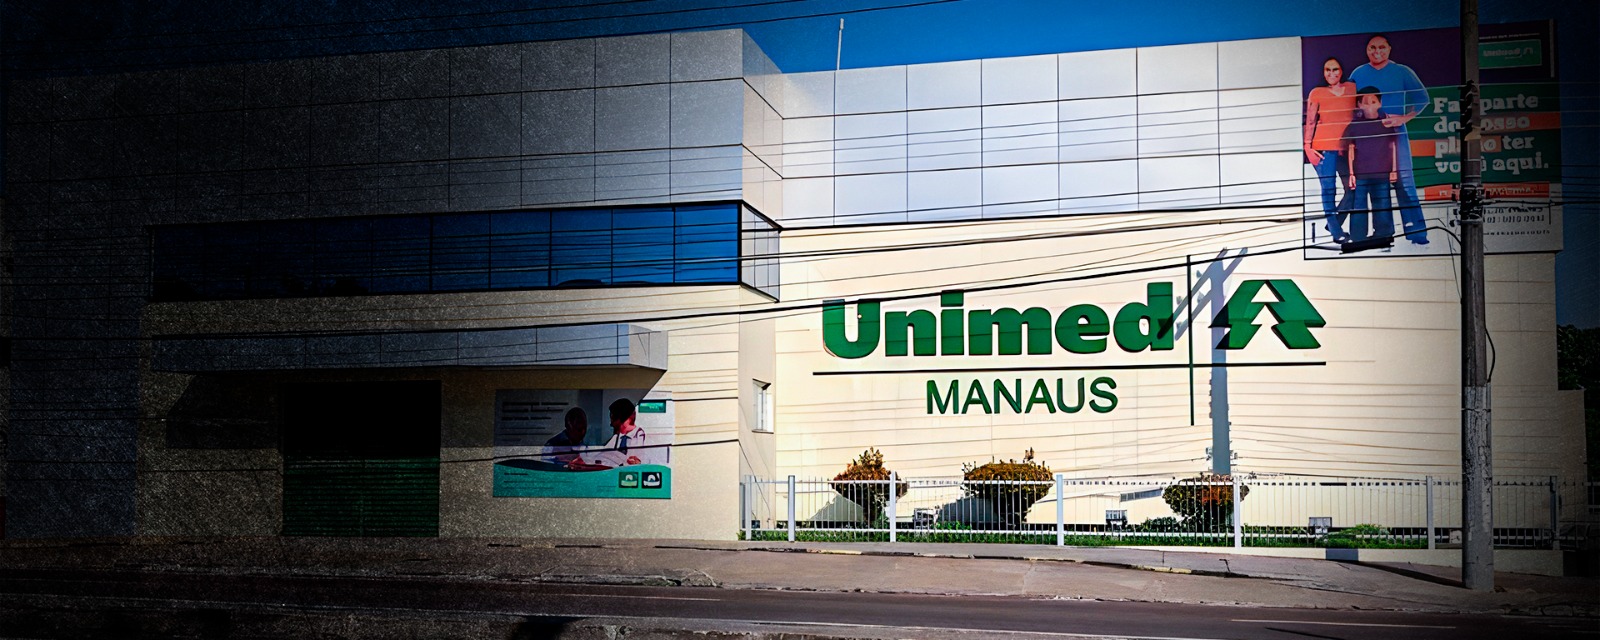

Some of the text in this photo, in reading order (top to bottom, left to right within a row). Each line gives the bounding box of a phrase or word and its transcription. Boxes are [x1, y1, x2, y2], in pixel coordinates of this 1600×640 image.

[1433, 93, 1539, 116] Fa parte
[1479, 116, 1530, 132] osso
[1434, 135, 1535, 159] plo ter
[1492, 151, 1549, 175] aqui.
[822, 281, 1174, 360] Unimed
[926, 376, 1119, 415] MANAUS
